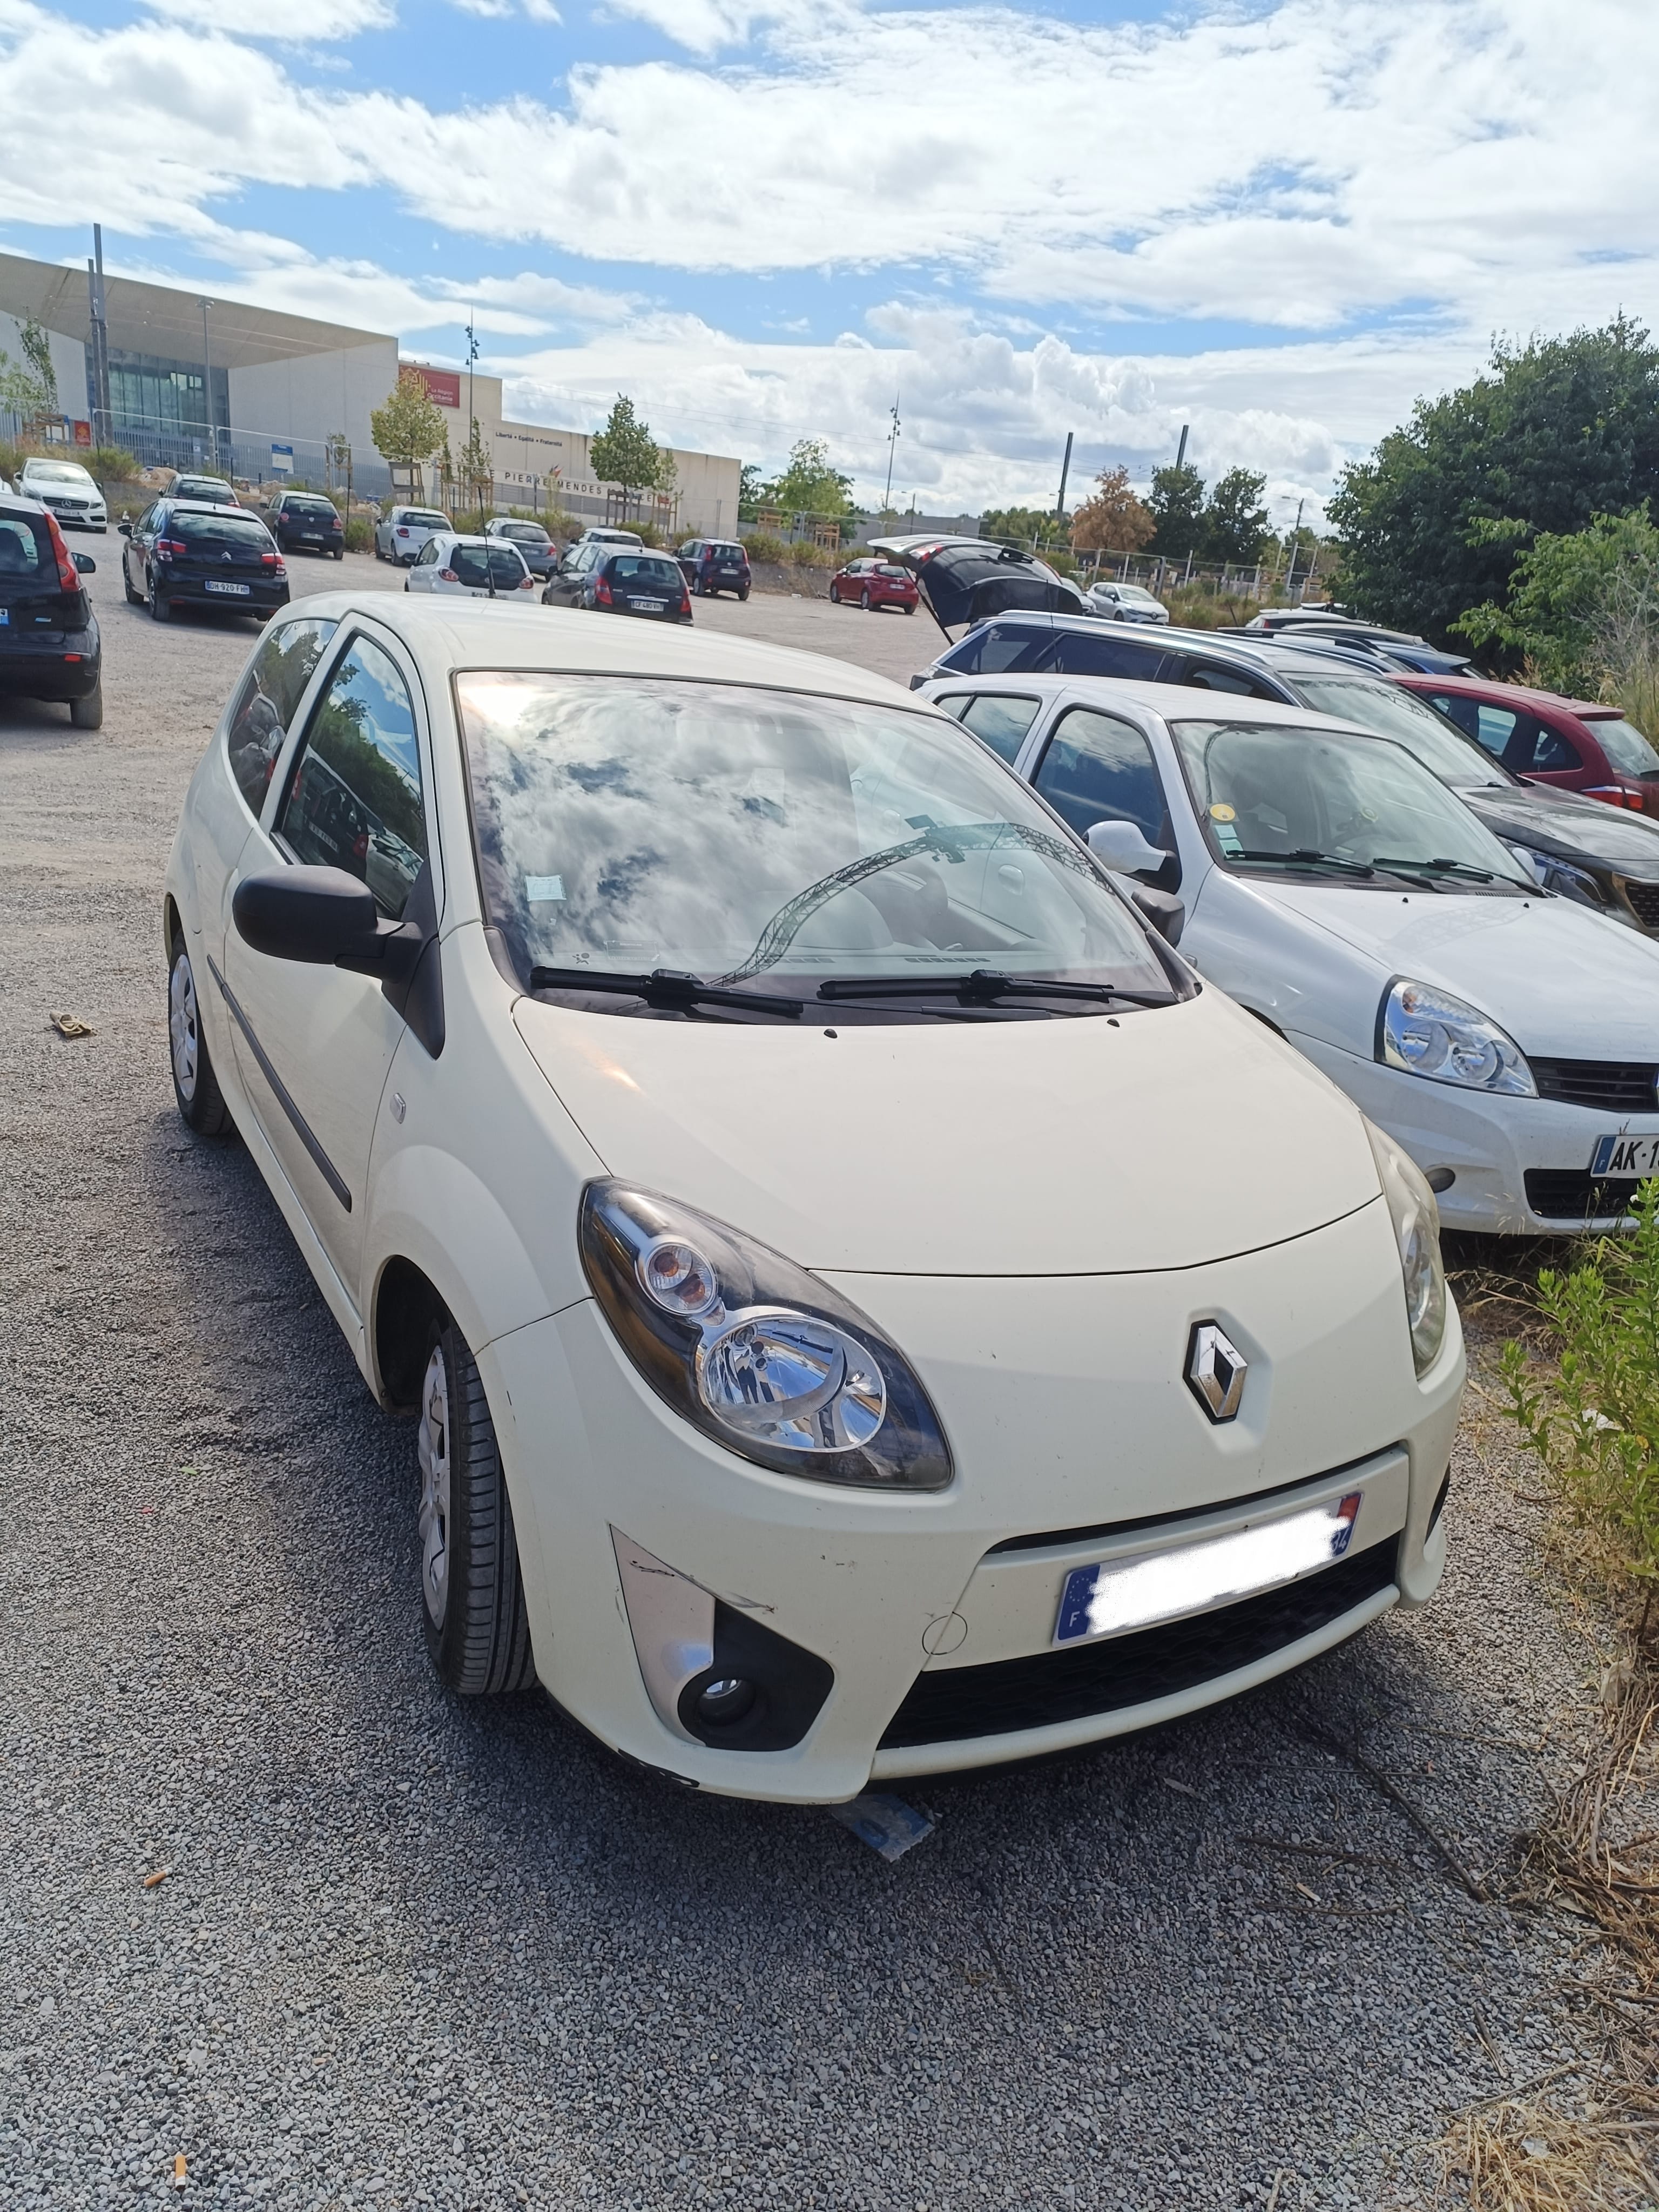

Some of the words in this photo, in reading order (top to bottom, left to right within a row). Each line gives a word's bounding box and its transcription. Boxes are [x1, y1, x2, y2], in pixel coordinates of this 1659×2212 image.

[505, 471, 548, 486] PIERRE
[1609, 1140, 1659, 1171] AK-1
[1069, 1611, 1080, 1627] F
